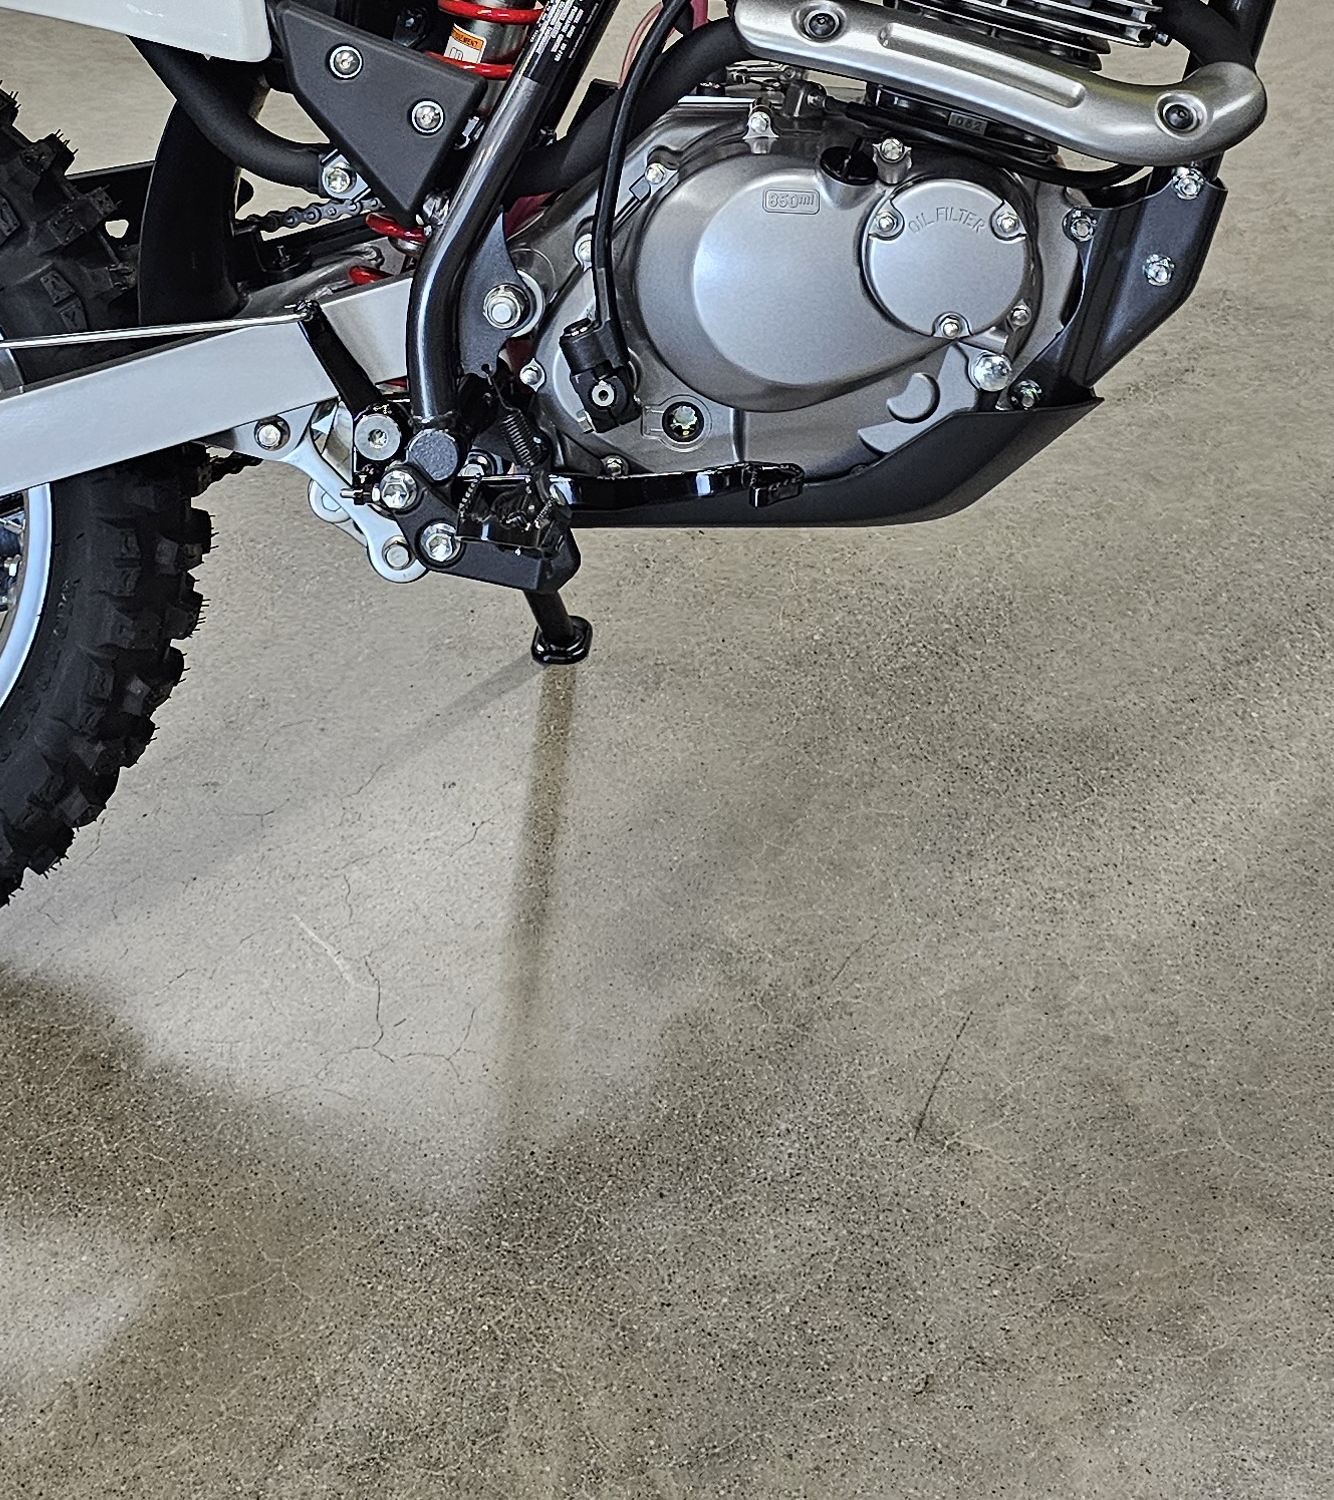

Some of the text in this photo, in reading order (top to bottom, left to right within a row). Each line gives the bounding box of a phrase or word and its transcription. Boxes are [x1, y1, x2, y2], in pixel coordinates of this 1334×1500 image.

[767, 193, 815, 208] 850ml
[908, 206, 986, 234] OIL FILTER
